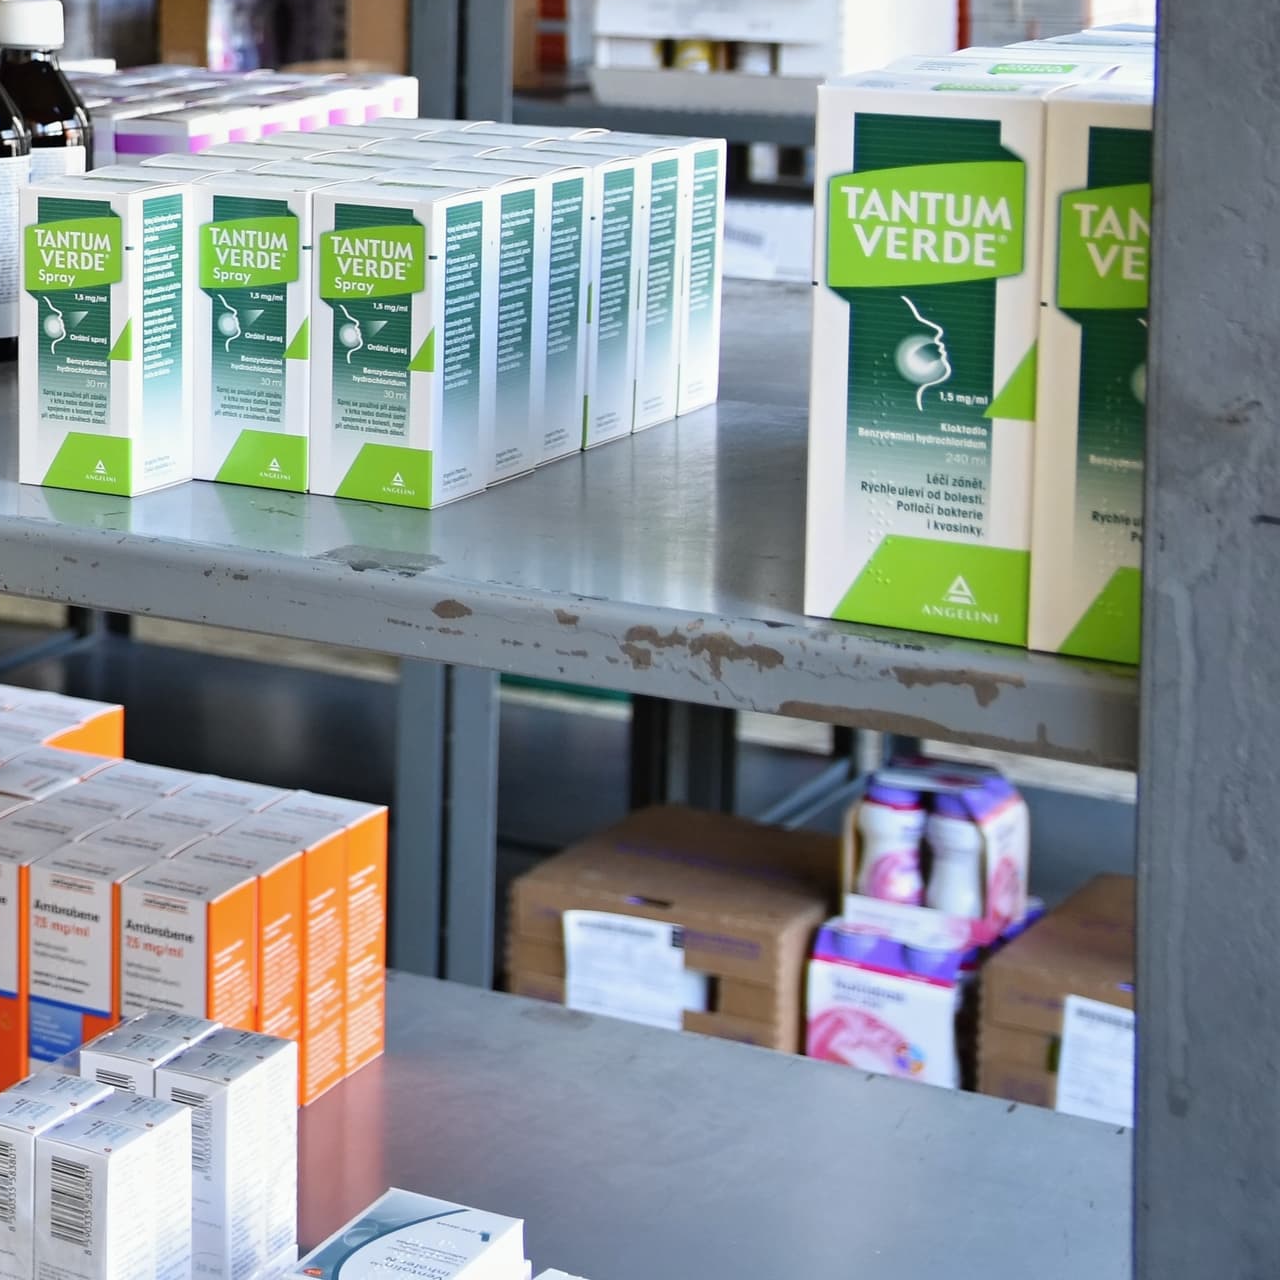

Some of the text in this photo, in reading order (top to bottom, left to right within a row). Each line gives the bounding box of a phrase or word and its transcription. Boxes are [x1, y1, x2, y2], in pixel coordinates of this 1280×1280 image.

[841, 186, 1012, 231] TANTUM
[1073, 203, 1150, 241] TAN
[35, 228, 111, 252] TANTUM
[209, 227, 288, 251] TANTUM
[330, 236, 413, 261] TANTUM
[40, 250, 106, 271] VERDE
[216, 248, 281, 270] VERDE
[337, 257, 407, 281] VERDE
[38, 268, 75, 287] Spray
[213, 267, 251, 285] Spray
[335, 277, 375, 295] Spray
[85, 294, 107, 303] mg/ml
[261, 293, 283, 303] mg/ml
[384, 303, 408, 313] mg/ml
[940, 391, 988, 406] 1,5 mg/ml
[858, 427, 987, 450] Benzydamini hydrochloridum
[941, 423, 987, 436] Kloktadlo
[945, 453, 969, 465] 240
[85, 473, 116, 484] ANGELINI
[259, 471, 291, 481] ANGELINI
[927, 472, 987, 491] Léčí zánět.
[382, 486, 415, 496] ANGELINI
[861, 481, 985, 505] Rychle uleví od bolesti.
[897, 500, 984, 521] Potlačí bakterie
[933, 520, 985, 537] kvasinky.
[921, 604, 999, 625] ANGELINI
[33, 898, 101, 924] Ambrobene
[125, 919, 195, 944] Ambrobene
